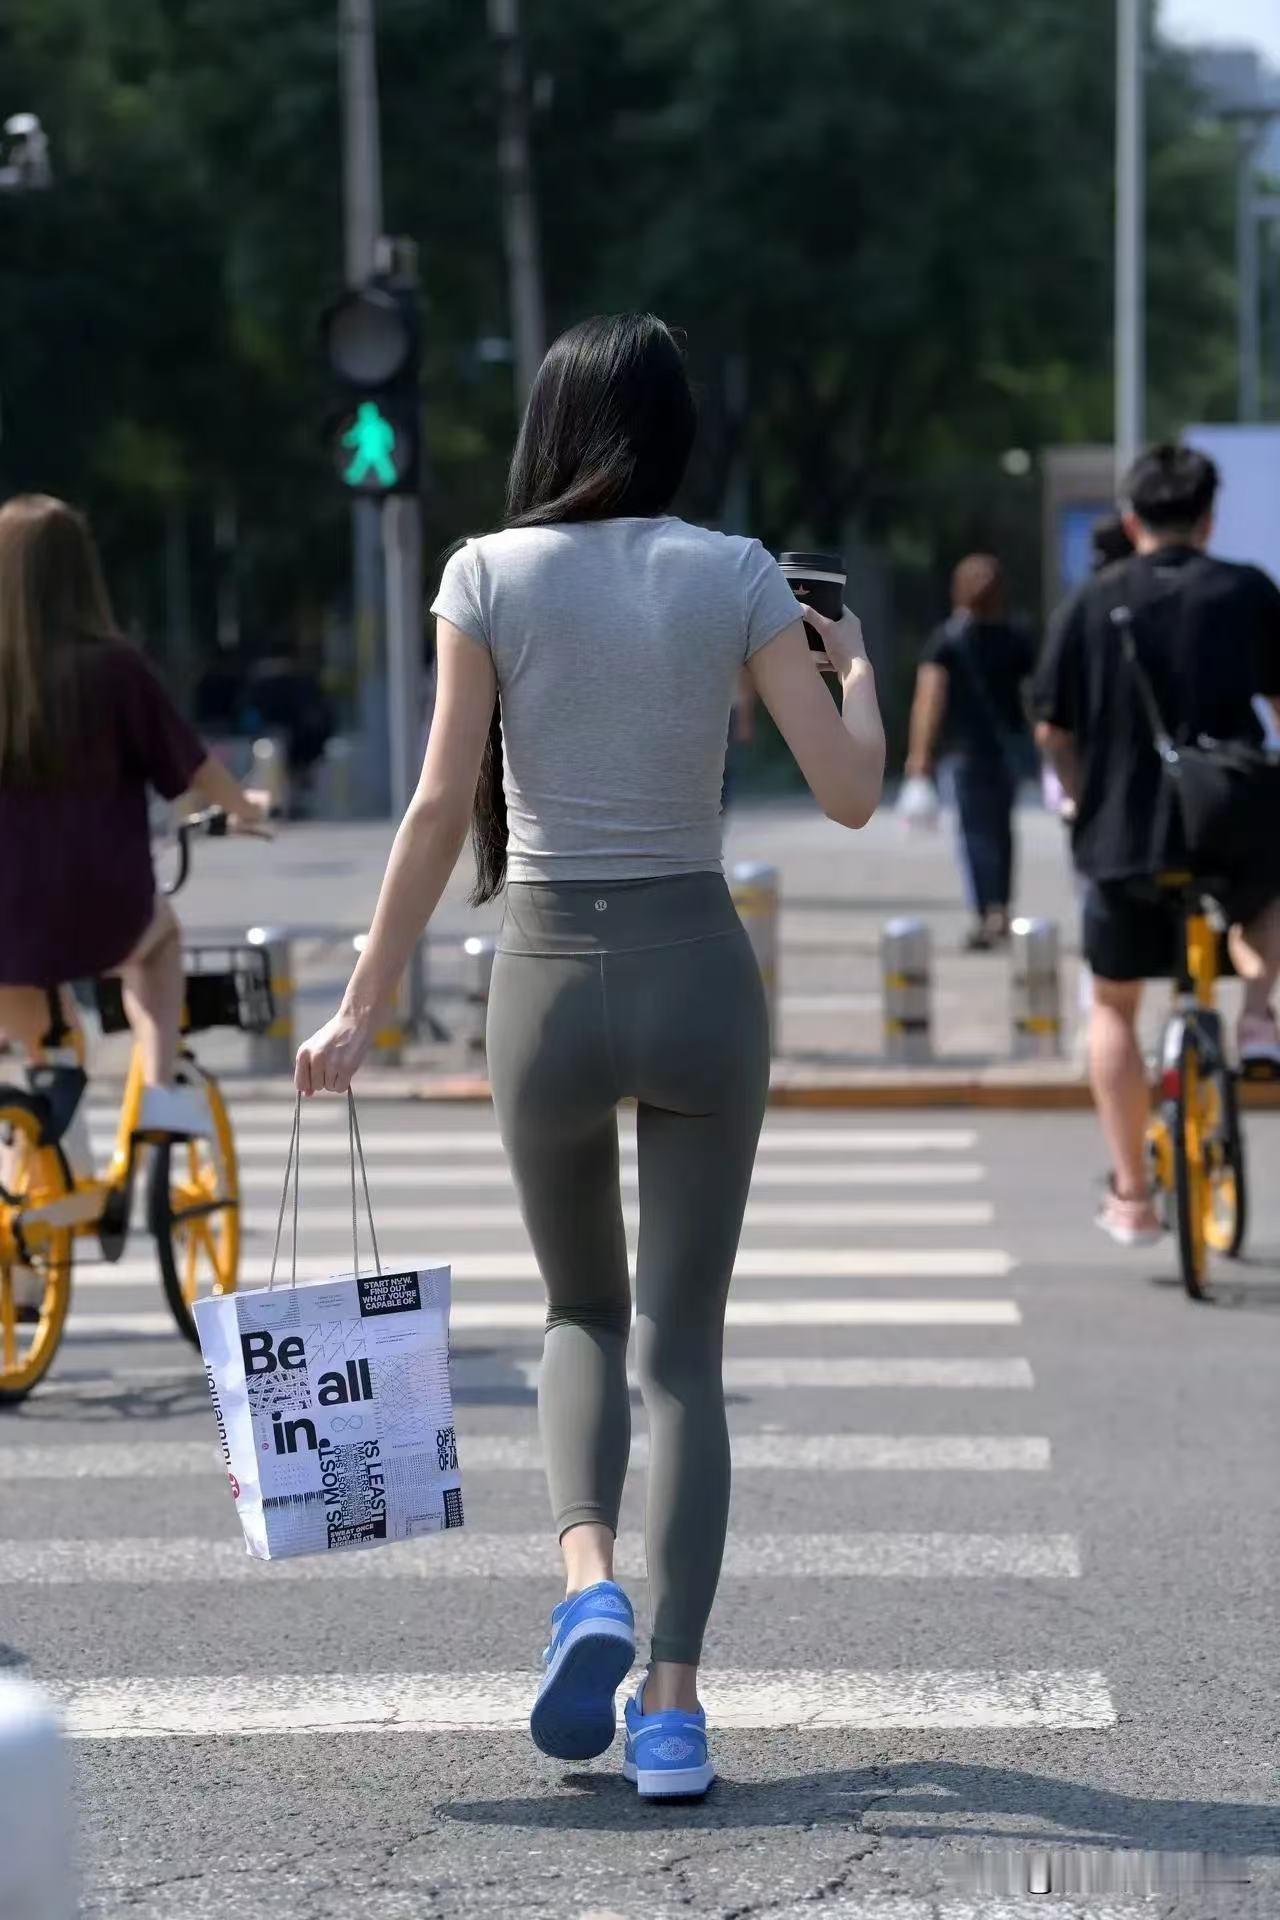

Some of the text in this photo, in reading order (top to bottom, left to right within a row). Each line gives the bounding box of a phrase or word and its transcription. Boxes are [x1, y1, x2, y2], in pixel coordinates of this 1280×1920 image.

[362, 1289, 417, 1304] WHAT YOU'RE
[363, 1280, 390, 1290] START
[370, 1284, 407, 1296] FIND OUT
[365, 1299, 402, 1310] CAPABLE
[240, 1331, 307, 1376] Be
[317, 1358, 374, 1407] all
[318, 1448, 341, 1506] MOST
[357, 1447, 370, 1492] MATTERS
[337, 1471, 348, 1498] MOST
[366, 1462, 387, 1521] LEAST
[337, 1534, 351, 1542] DAY
